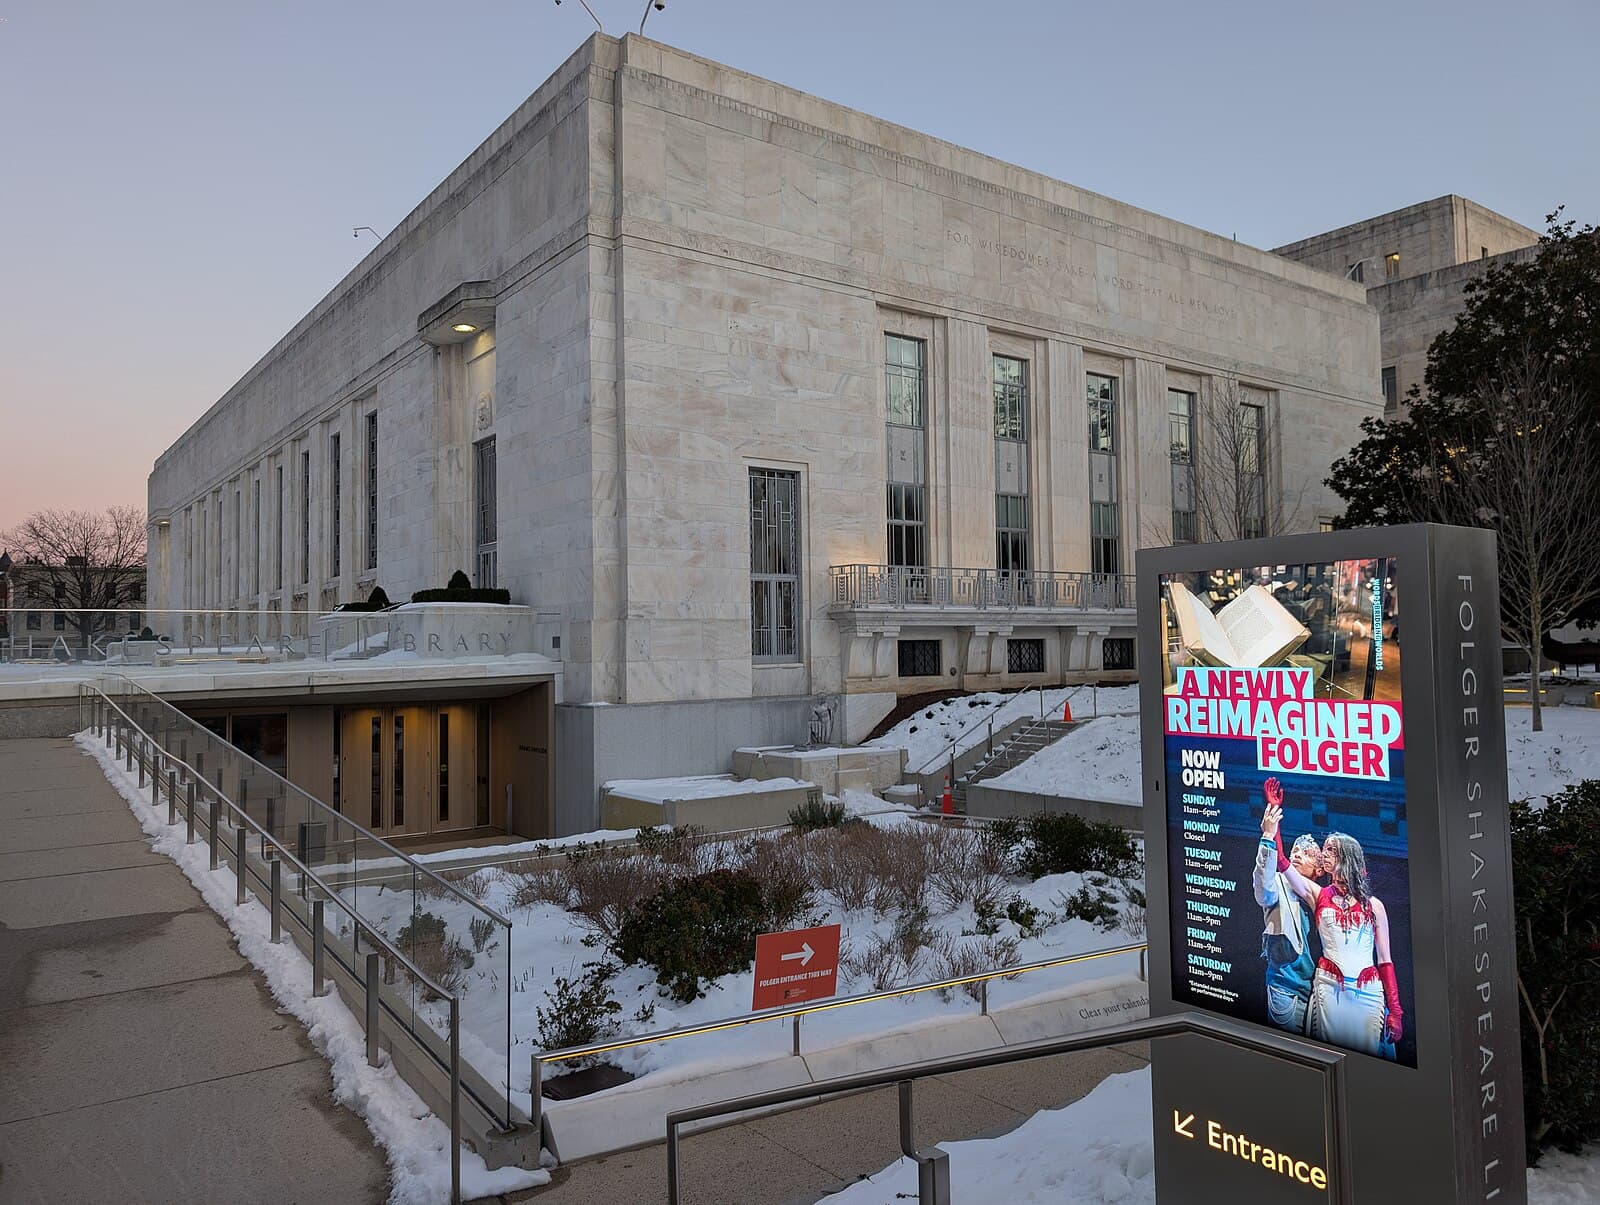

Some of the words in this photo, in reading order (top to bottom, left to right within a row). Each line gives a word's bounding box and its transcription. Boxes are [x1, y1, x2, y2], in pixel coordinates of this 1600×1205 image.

[947, 230, 971, 246] FOR
[978, 239, 1049, 266] WISEDOMES
[1103, 274, 1133, 290] WORD
[1167, 293, 1185, 305] ALL
[1190, 298, 1208, 312] MEN
[1458, 575, 1480, 759] FOLGER
[1182, 670, 1200, 696] A
[1208, 670, 1310, 699] NEWLY
[1167, 698, 1402, 744] REIMAGINED
[1181, 749, 1220, 769] NOW
[1261, 737, 1386, 777] FOLGER
[1182, 768, 1225, 789] OPEN
[1182, 793, 1216, 806] SUNDAY
[1183, 820, 1220, 834] MONDAY
[1184, 831, 1206, 842] Closed
[1184, 847, 1222, 861] TUESDAY
[1185, 873, 1237, 891] WEDNESDAY
[1186, 900, 1231, 918] THURSDAY
[1187, 927, 1217, 942] FRIDAY
[1188, 953, 1232, 973] SATURDAY
[1467, 781, 1498, 1138] SHAKESPEARE
[760, 979, 779, 987] FOLGER
[780, 973, 807, 984] ENTRANCE
[1079, 1008, 1101, 1020] Clear
[1102, 1004, 1122, 1016] your
[1208, 1120, 1327, 1190] Entrance
